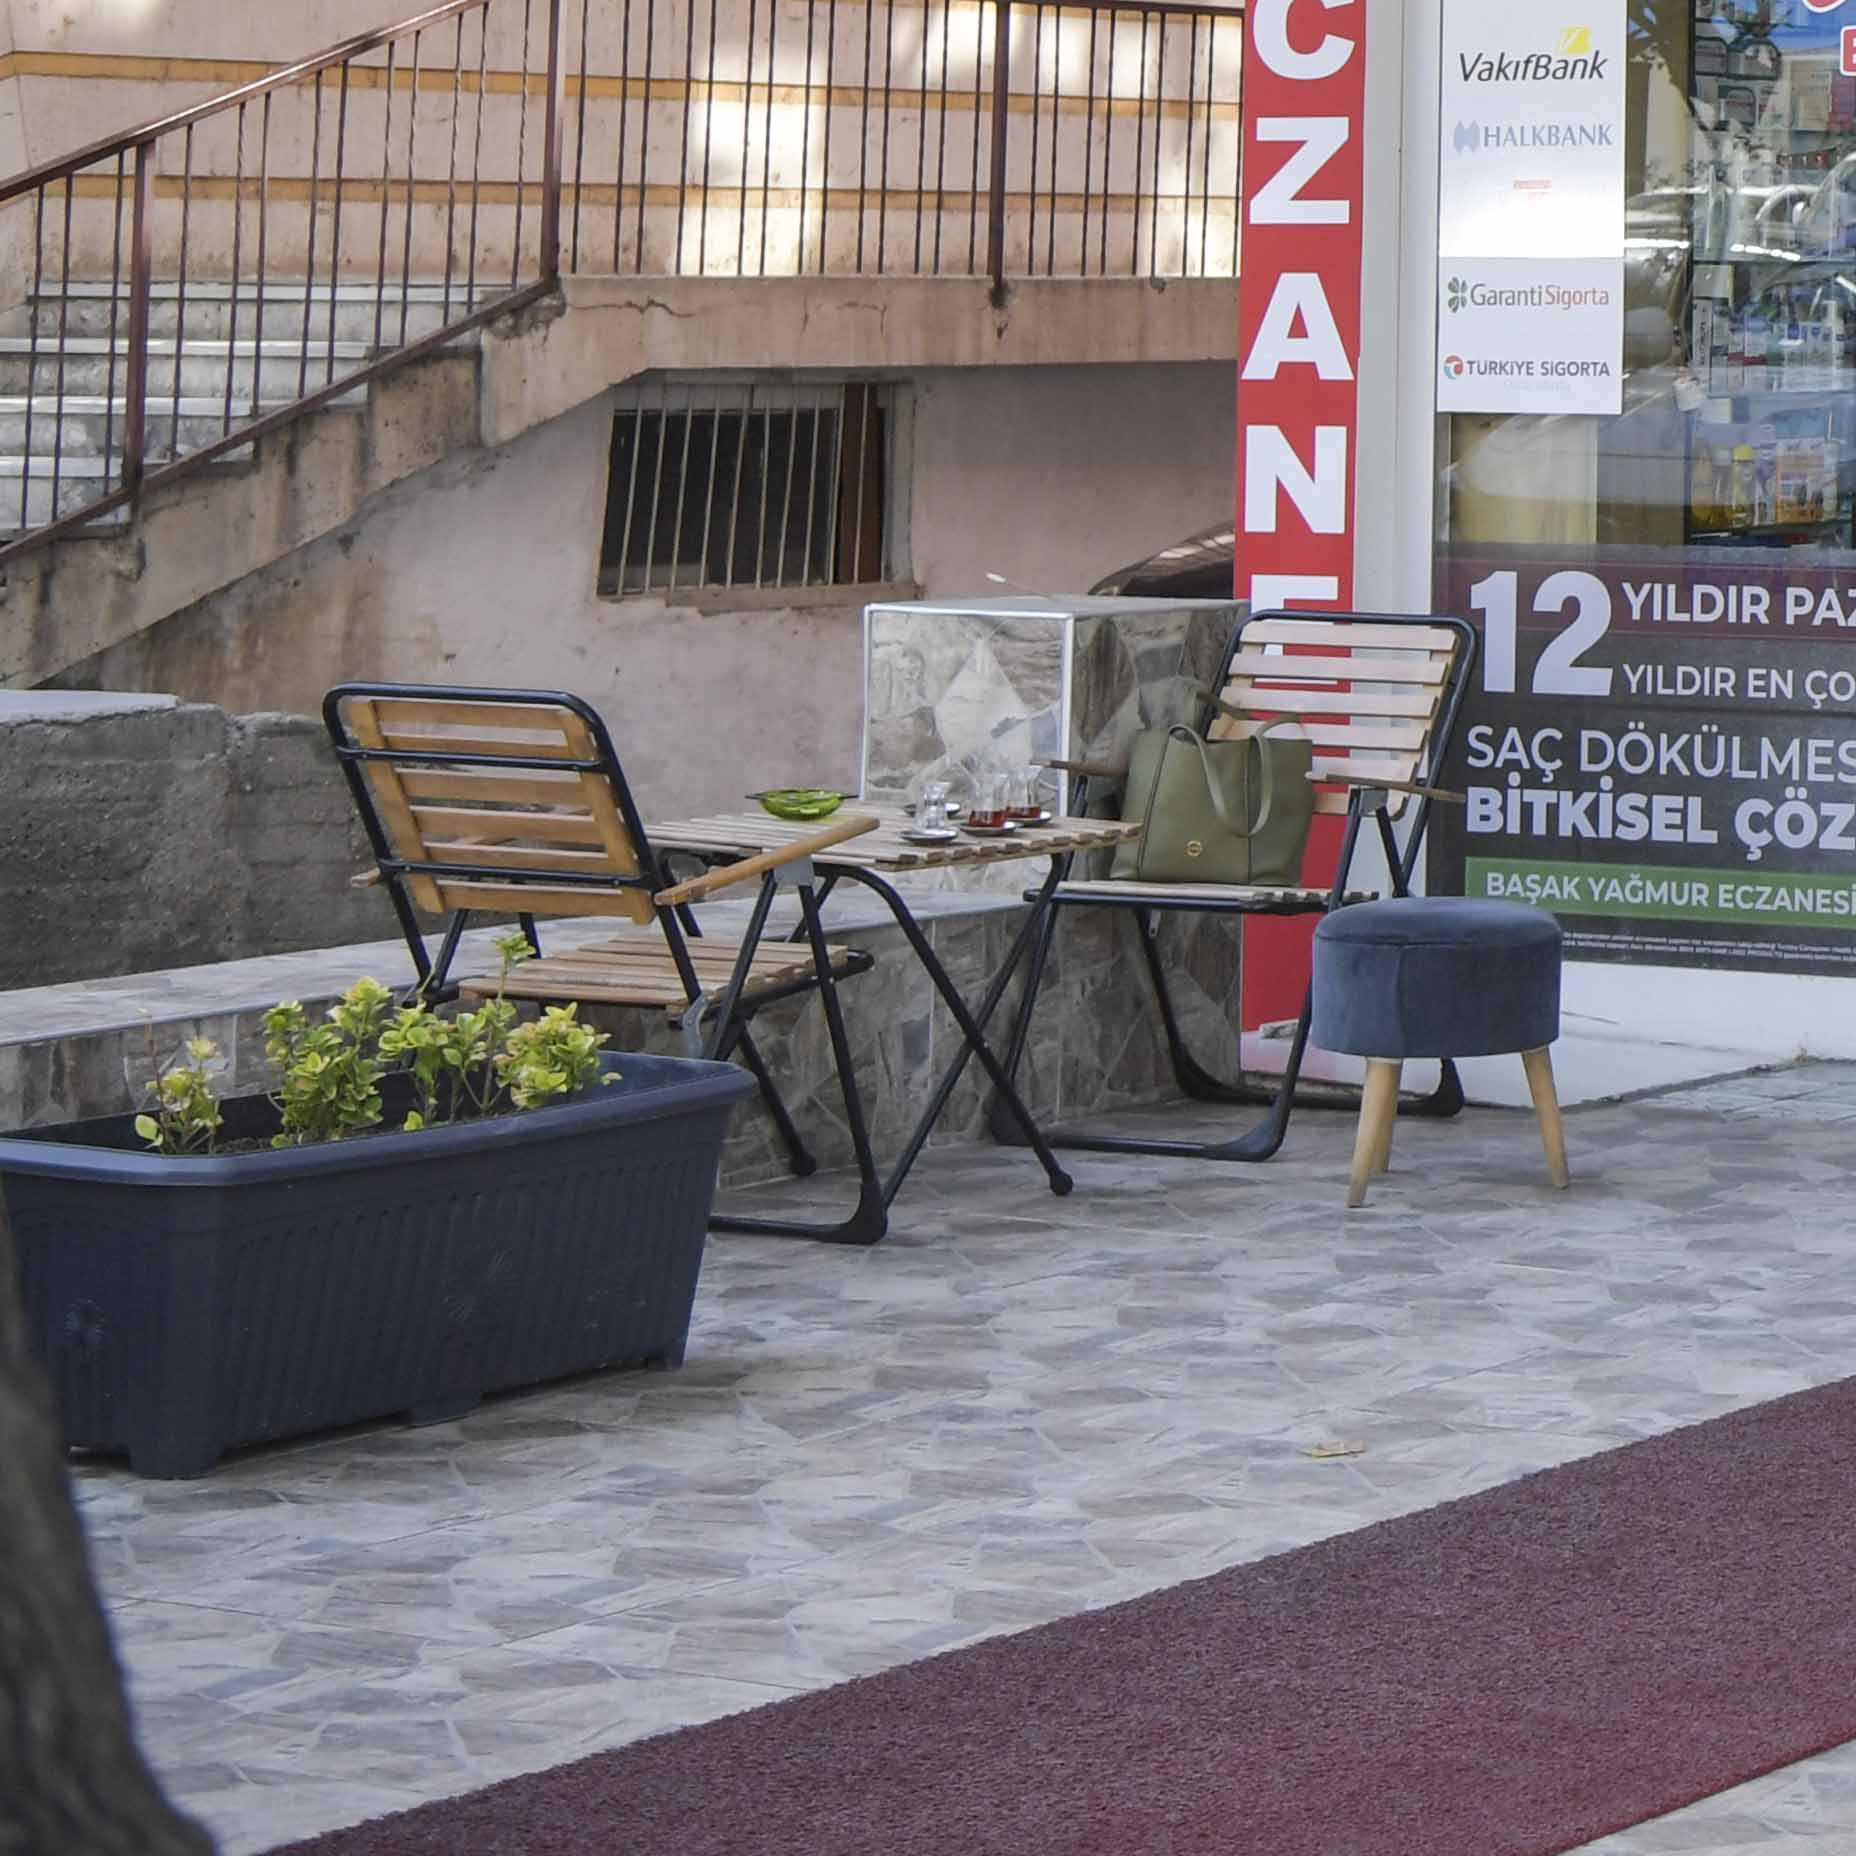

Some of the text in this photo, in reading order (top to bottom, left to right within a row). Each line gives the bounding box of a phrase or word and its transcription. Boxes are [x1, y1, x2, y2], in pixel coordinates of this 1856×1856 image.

[1459, 49, 1608, 83] VakıfBank
[1483, 123, 1613, 148] HALKBANK
[1470, 570, 1613, 697] 12
[1621, 581, 1771, 625] YILDIR
[1622, 663, 1735, 697] YILDIR
[1747, 668, 1793, 700] EN
[1468, 725, 1563, 783] SAÇ
[1466, 773, 1718, 844] BİTKİSEL
[1487, 871, 1581, 906] BAŞAK
[1588, 873, 1709, 908] YAĞMUR
